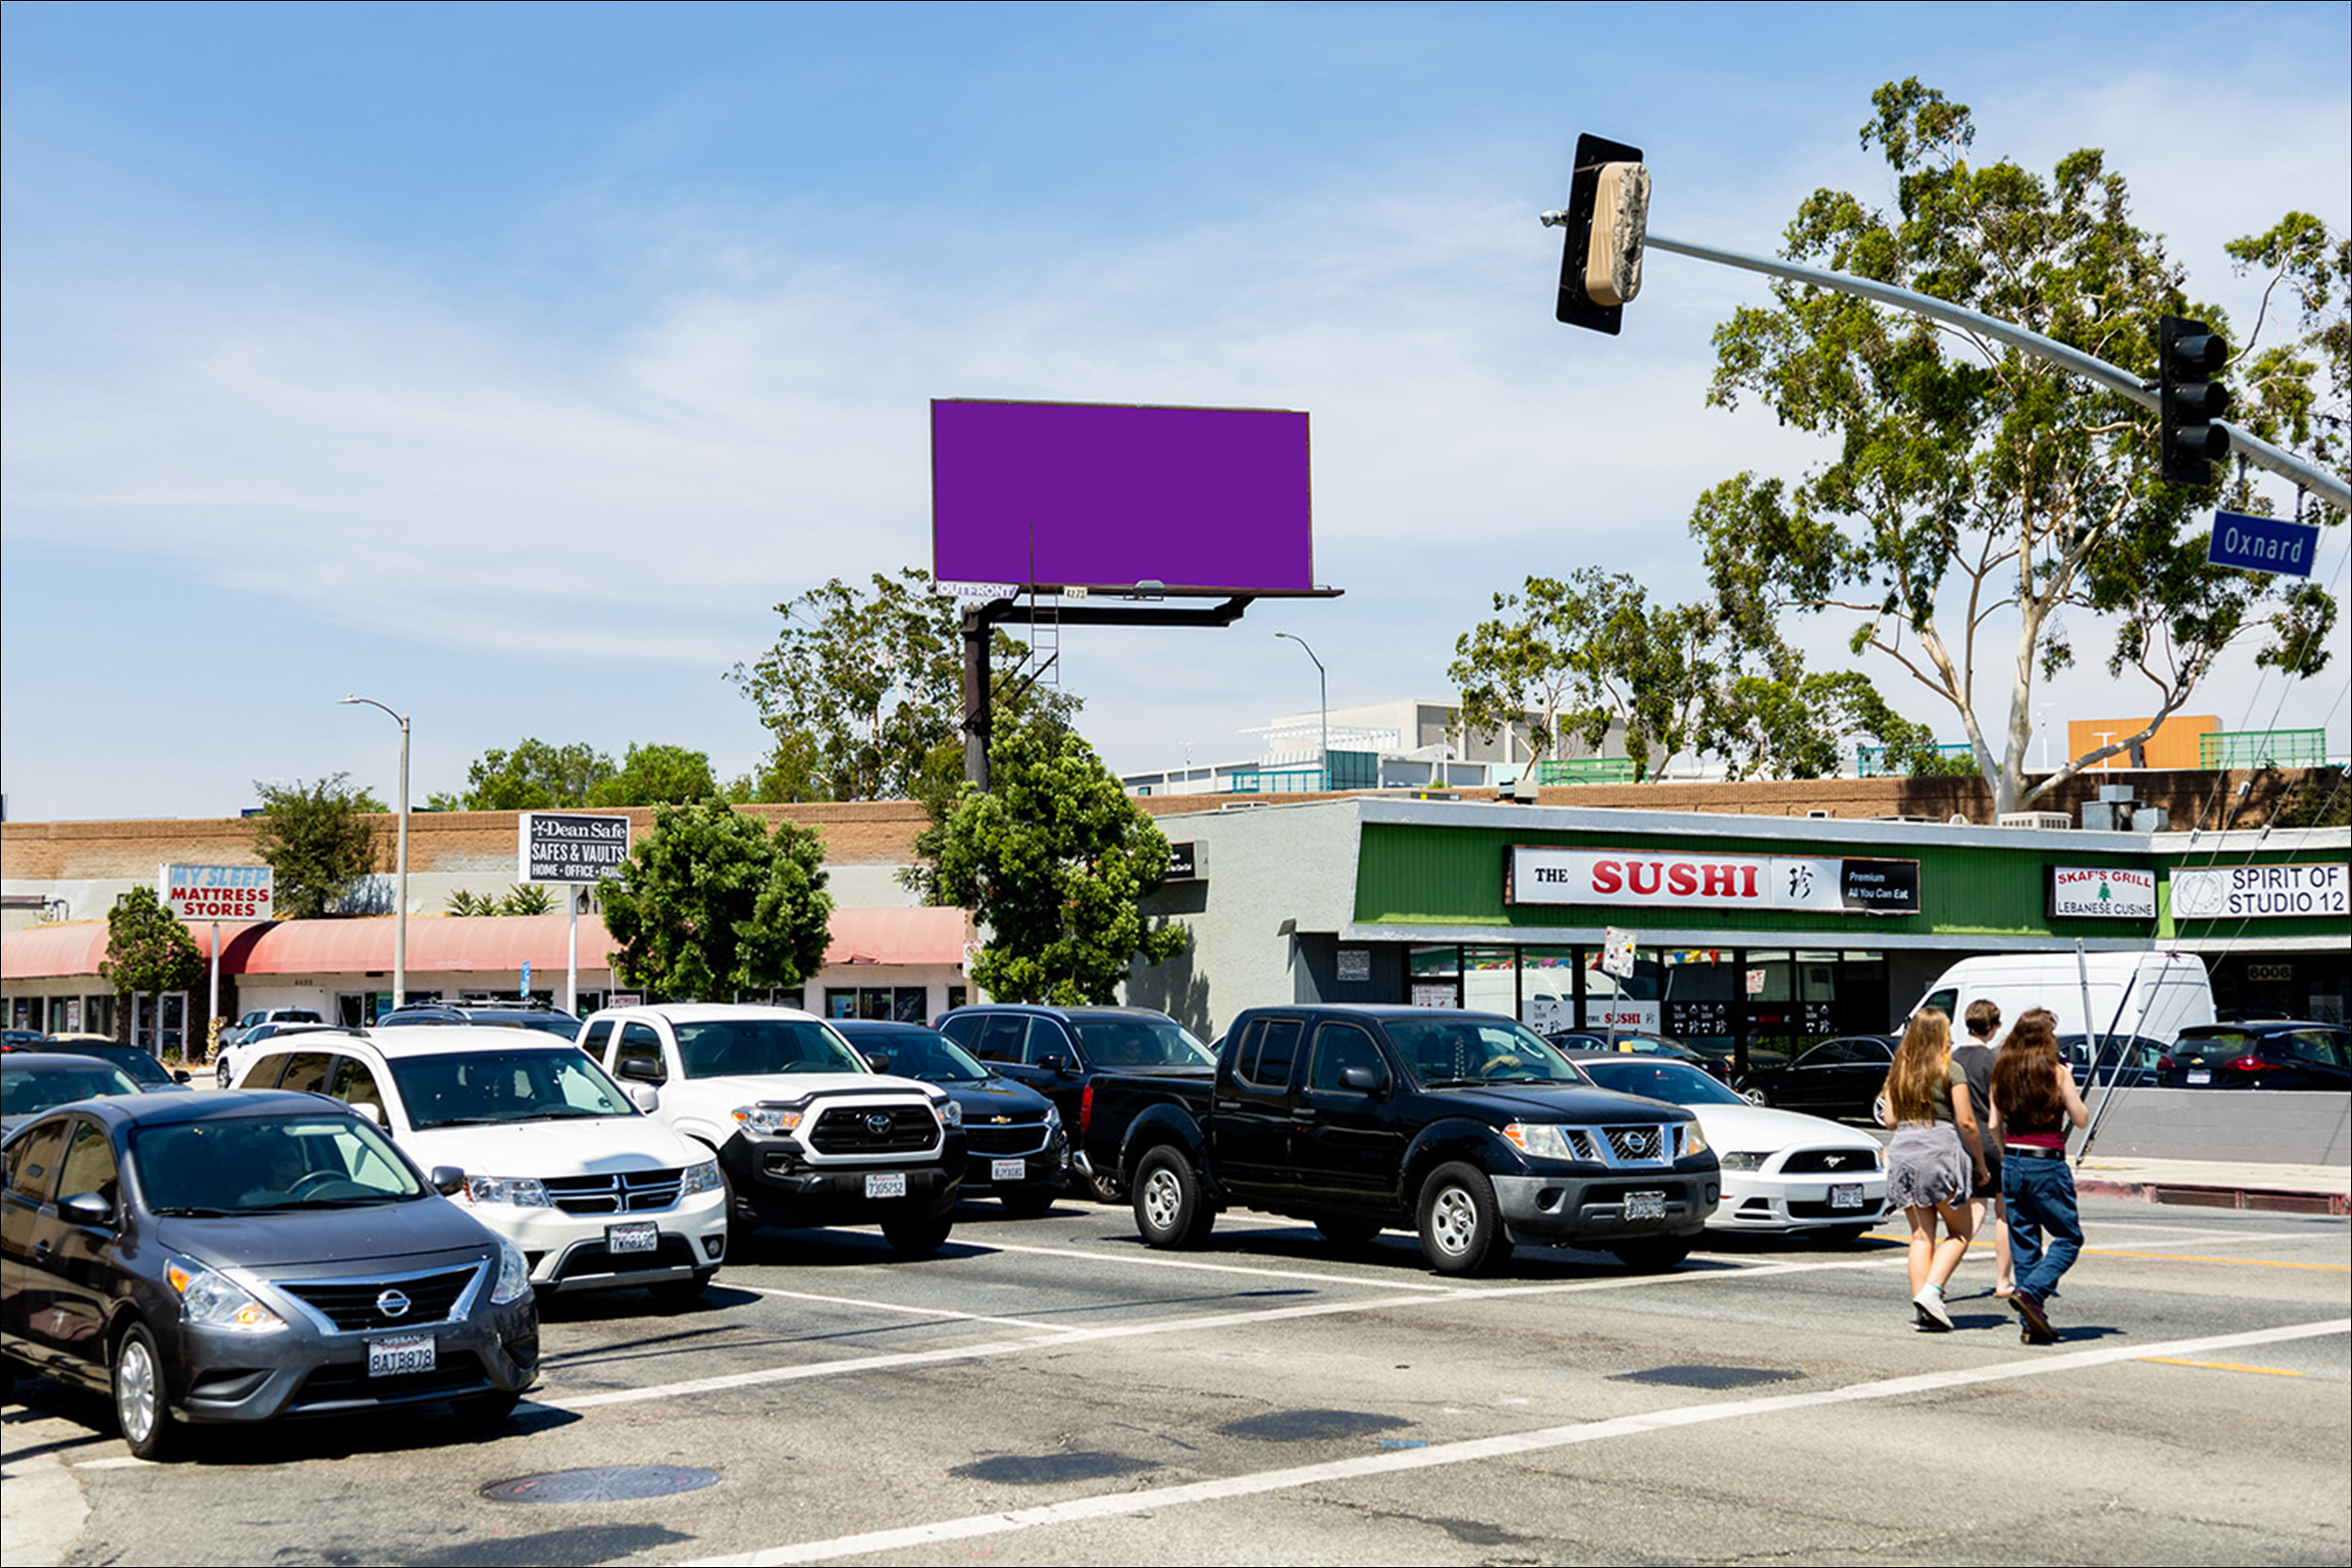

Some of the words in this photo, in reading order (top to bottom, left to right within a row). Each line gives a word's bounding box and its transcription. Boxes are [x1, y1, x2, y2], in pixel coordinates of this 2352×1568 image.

[2225, 527, 2304, 563] Oxnard
[939, 582, 1013, 599] OUTFRONT
[546, 820, 589, 837] Dean
[590, 821, 626, 839] Safe
[531, 843, 568, 861] SAFES
[569, 844, 579, 861] &
[581, 845, 625, 862] VAULTS
[172, 867, 204, 885] MY
[206, 868, 270, 887] SLEEP
[532, 863, 558, 876] HOME
[564, 864, 594, 878] OFFICE
[1534, 867, 1569, 883] THE
[1592, 859, 1759, 899] SUSHI
[1849, 870, 1886, 882] Premium
[2058, 870, 2107, 885] SKAF'S
[2111, 871, 2151, 888] GRILL
[2232, 867, 2302, 890] SPIRIT
[2309, 866, 2339, 888] OF
[171, 887, 270, 903] MATTRESS
[1847, 887, 1858, 898] All
[1860, 887, 1875, 898] You
[1876, 888, 1892, 899] Can
[1893, 888, 1909, 900] Eat
[2230, 892, 2313, 914] STUDIO
[2320, 891, 2344, 911] 12
[183, 902, 256, 916] STORES
[2058, 902, 2111, 914] LEBANESE
[2114, 903, 2152, 915] CUSINE
